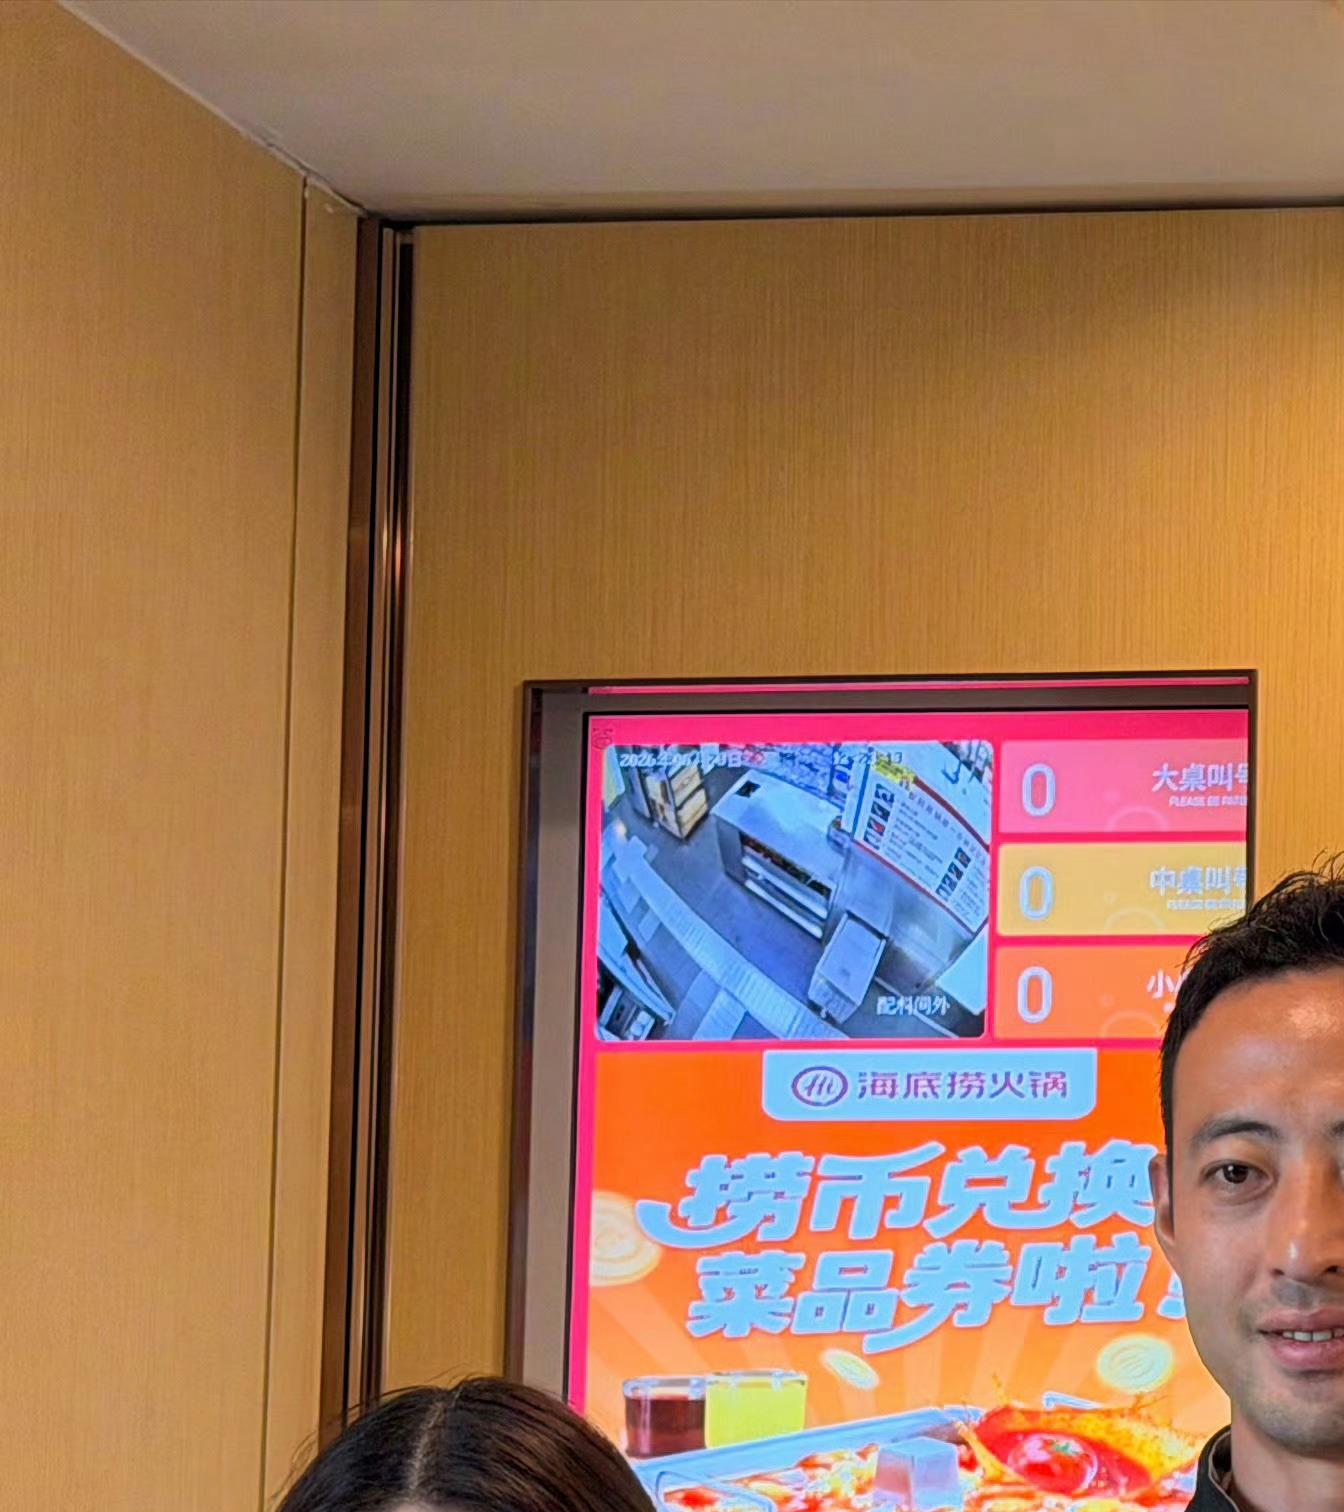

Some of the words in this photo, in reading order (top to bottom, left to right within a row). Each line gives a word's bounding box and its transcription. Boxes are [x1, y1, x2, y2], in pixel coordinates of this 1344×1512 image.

[1022, 763, 1056, 817] 0
[1020, 866, 1054, 920] 0
[1017, 966, 1053, 1023] 0
[1146, 968, 1190, 999] 小
[857, 1071, 1068, 1099] 海底捞火锅
[636, 1140, 1158, 1250] 捞币兑换
